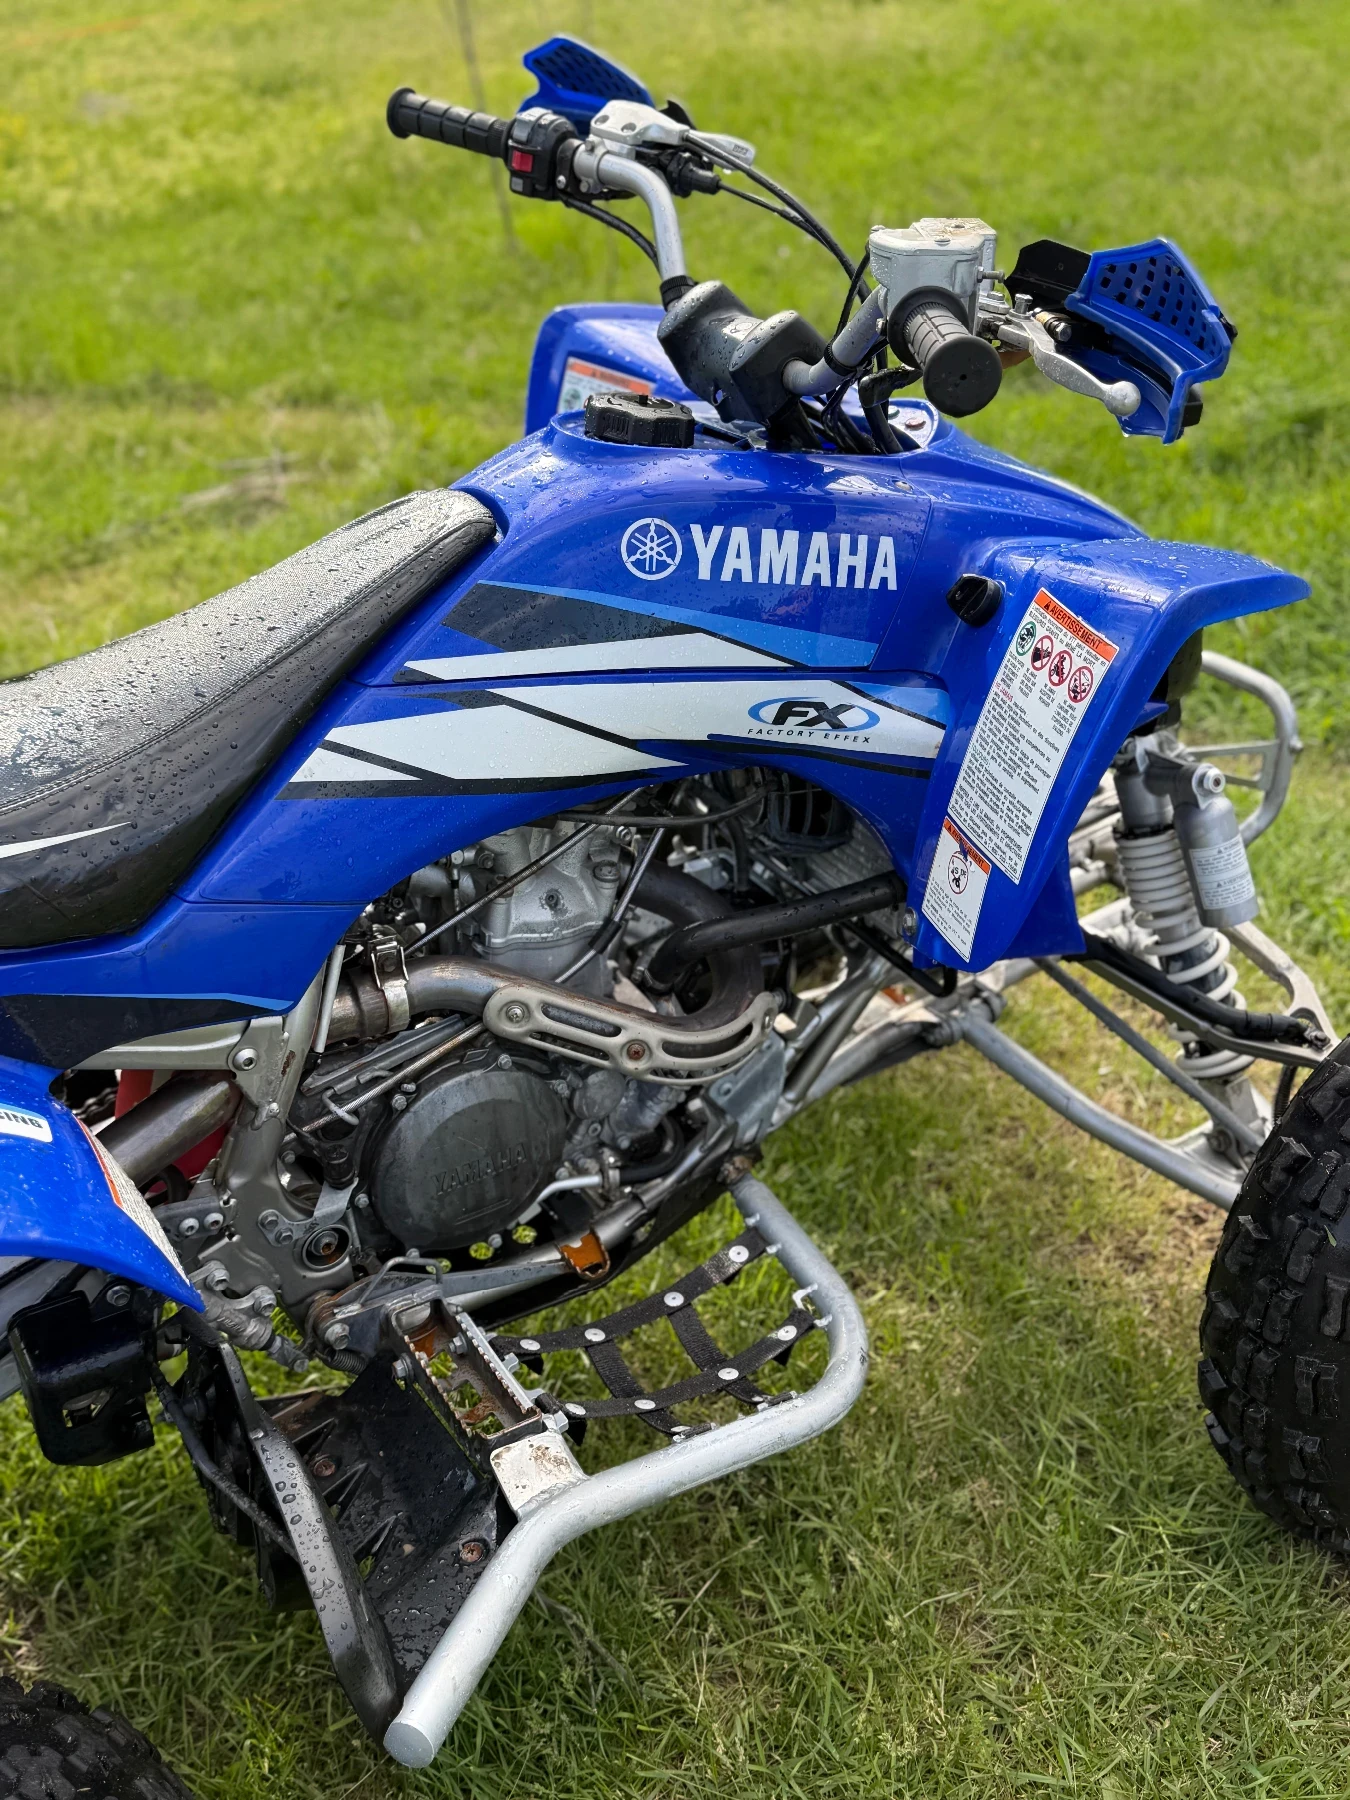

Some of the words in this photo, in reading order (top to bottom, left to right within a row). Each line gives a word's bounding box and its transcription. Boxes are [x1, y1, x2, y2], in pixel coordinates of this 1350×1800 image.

[690, 523, 897, 590] YAMAHA
[1050, 604, 1103, 650] AVERTISSEMENT
[747, 728, 815, 738] FACTORY
[823, 733, 871, 744] EFFEX
[772, 701, 856, 730] FX
[431, 1143, 527, 1195] YAMAHA
